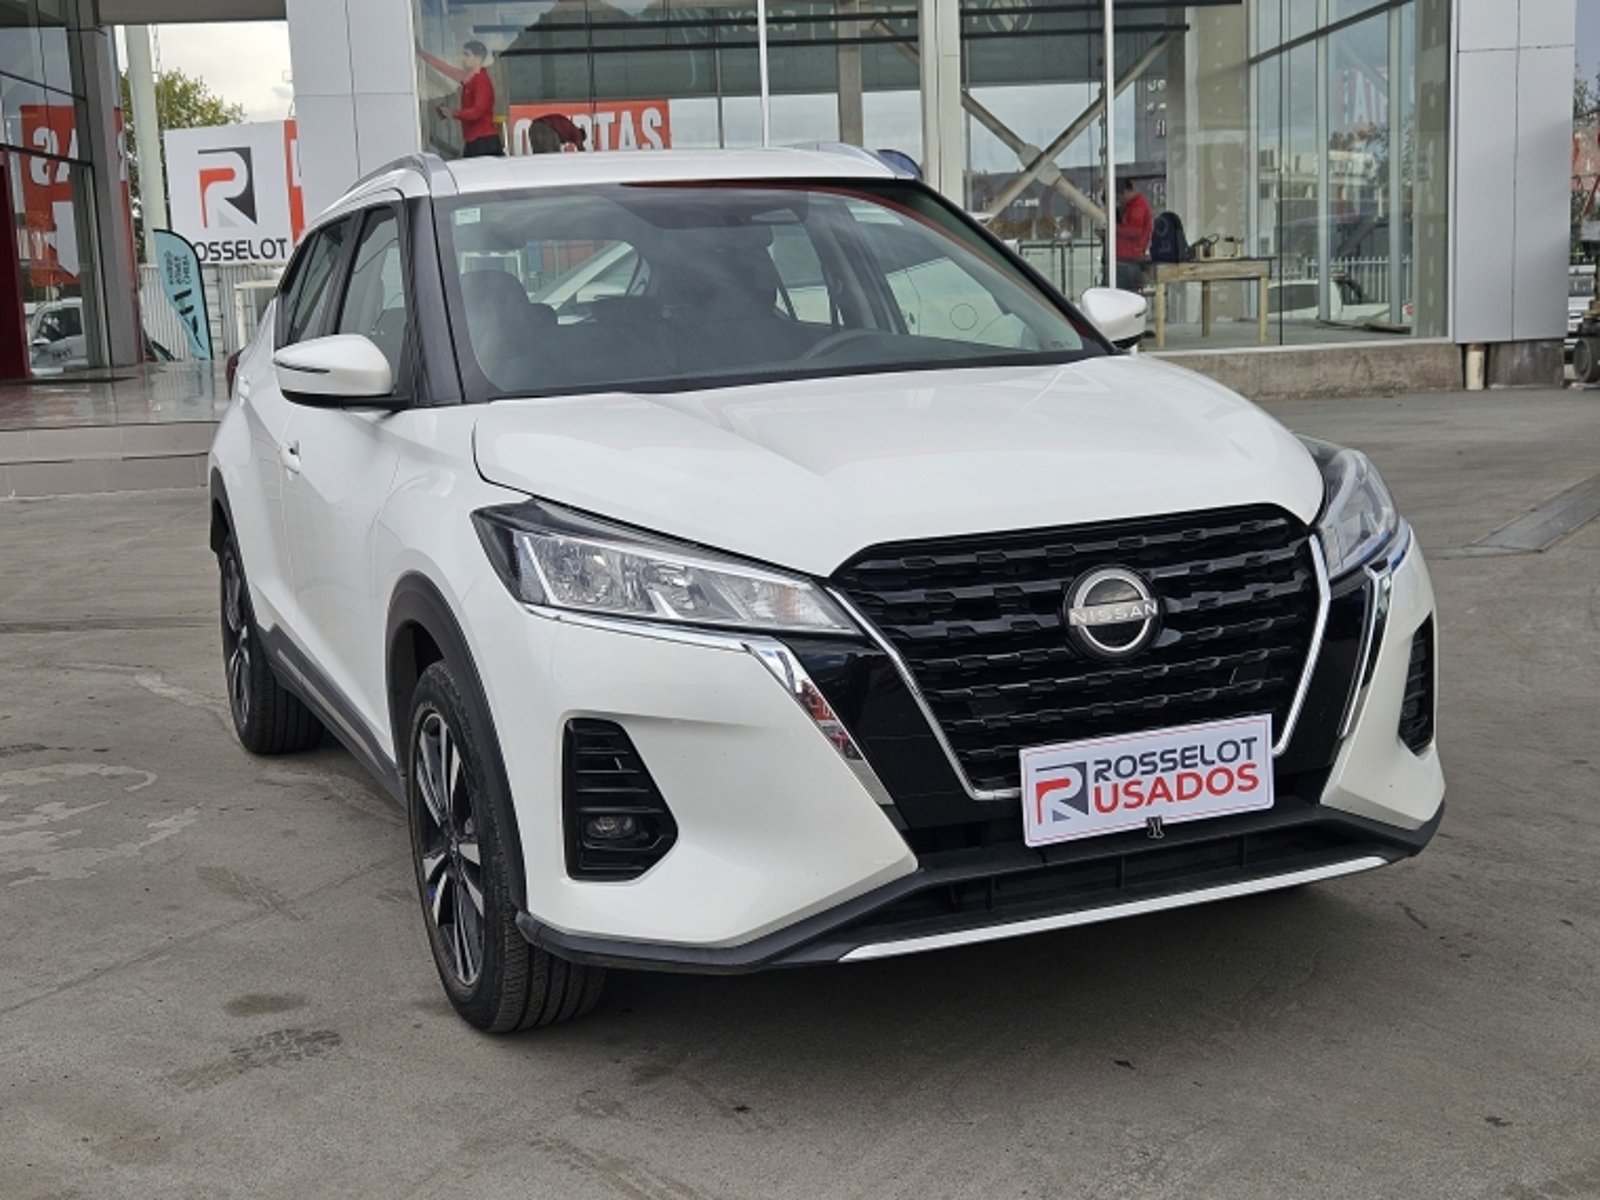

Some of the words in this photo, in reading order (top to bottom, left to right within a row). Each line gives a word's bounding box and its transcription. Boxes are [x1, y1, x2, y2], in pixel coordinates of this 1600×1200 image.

[193, 238, 287, 262] OSSELOT
[1071, 600, 1157, 625] NISSAN
[1094, 737, 1257, 783] ROSSELOT
[1094, 763, 1259, 813] USADOS
